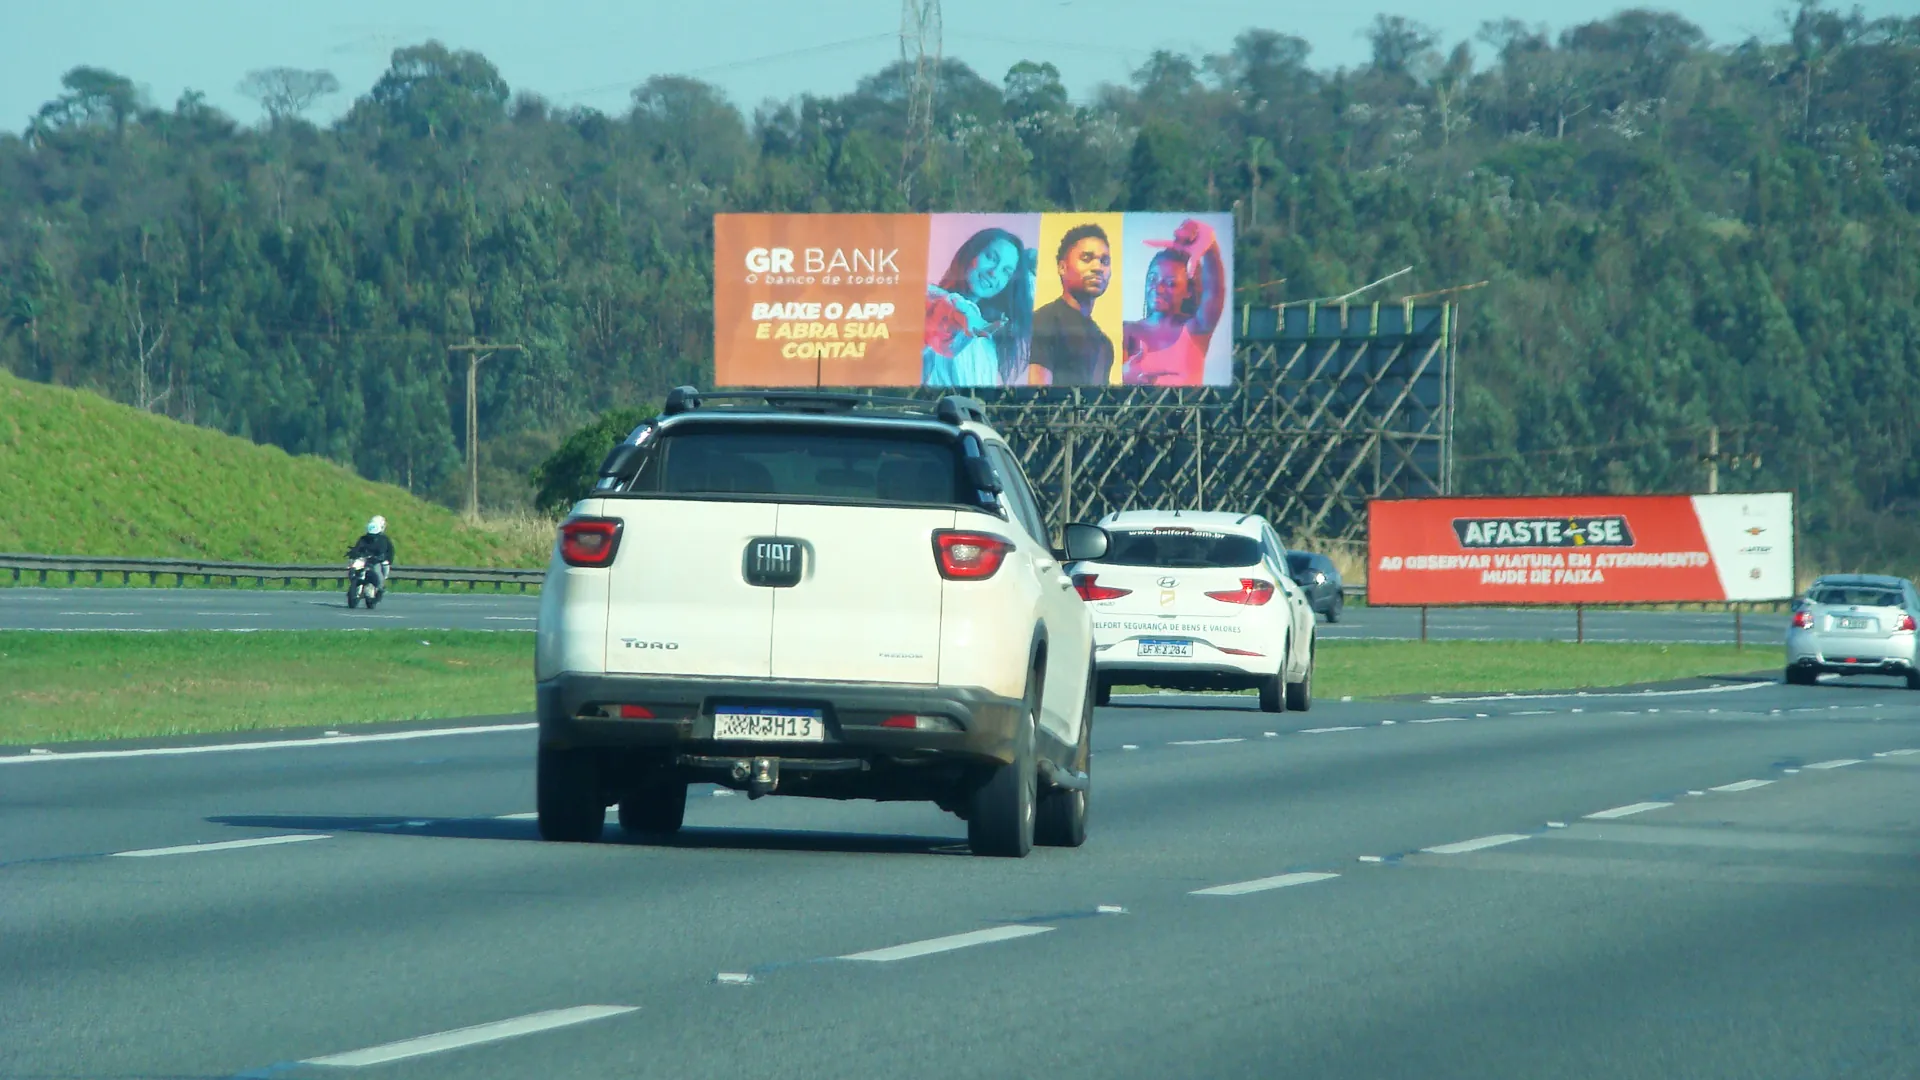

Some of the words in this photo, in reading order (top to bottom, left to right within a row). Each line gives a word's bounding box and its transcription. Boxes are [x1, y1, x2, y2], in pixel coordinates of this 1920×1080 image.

[745, 247, 794, 273] GR
[805, 248, 900, 273] BANK
[745, 274, 758, 284] O
[765, 274, 815, 284] banco
[822, 274, 841, 284] de
[847, 274, 900, 285] todos!
[752, 302, 821, 320] BAIXE
[824, 303, 842, 319] O
[845, 303, 895, 320] APP
[756, 323, 772, 339] E
[775, 323, 839, 339] ABRA
[843, 323, 890, 339] SUA
[781, 342, 865, 358] CONTA!
[1129, 529, 1225, 539] www.belfort.com.br
[757, 544, 794, 572] FIAT
[1380, 556, 1404, 570] AO
[1406, 554, 1491, 570] OBSERVAR
[1495, 554, 1564, 569] VIATURA
[1568, 553, 1591, 567] EM
[1595, 552, 1709, 567] ATENDIMENTO
[1482, 570, 1527, 584] MUDE
[1530, 570, 1551, 584] DE
[1554, 570, 1604, 583] FAIXA
[1124, 622, 1167, 631] SEGURANÇA
[1210, 625, 1241, 633] VALORES
[620, 638, 679, 650] TORO
